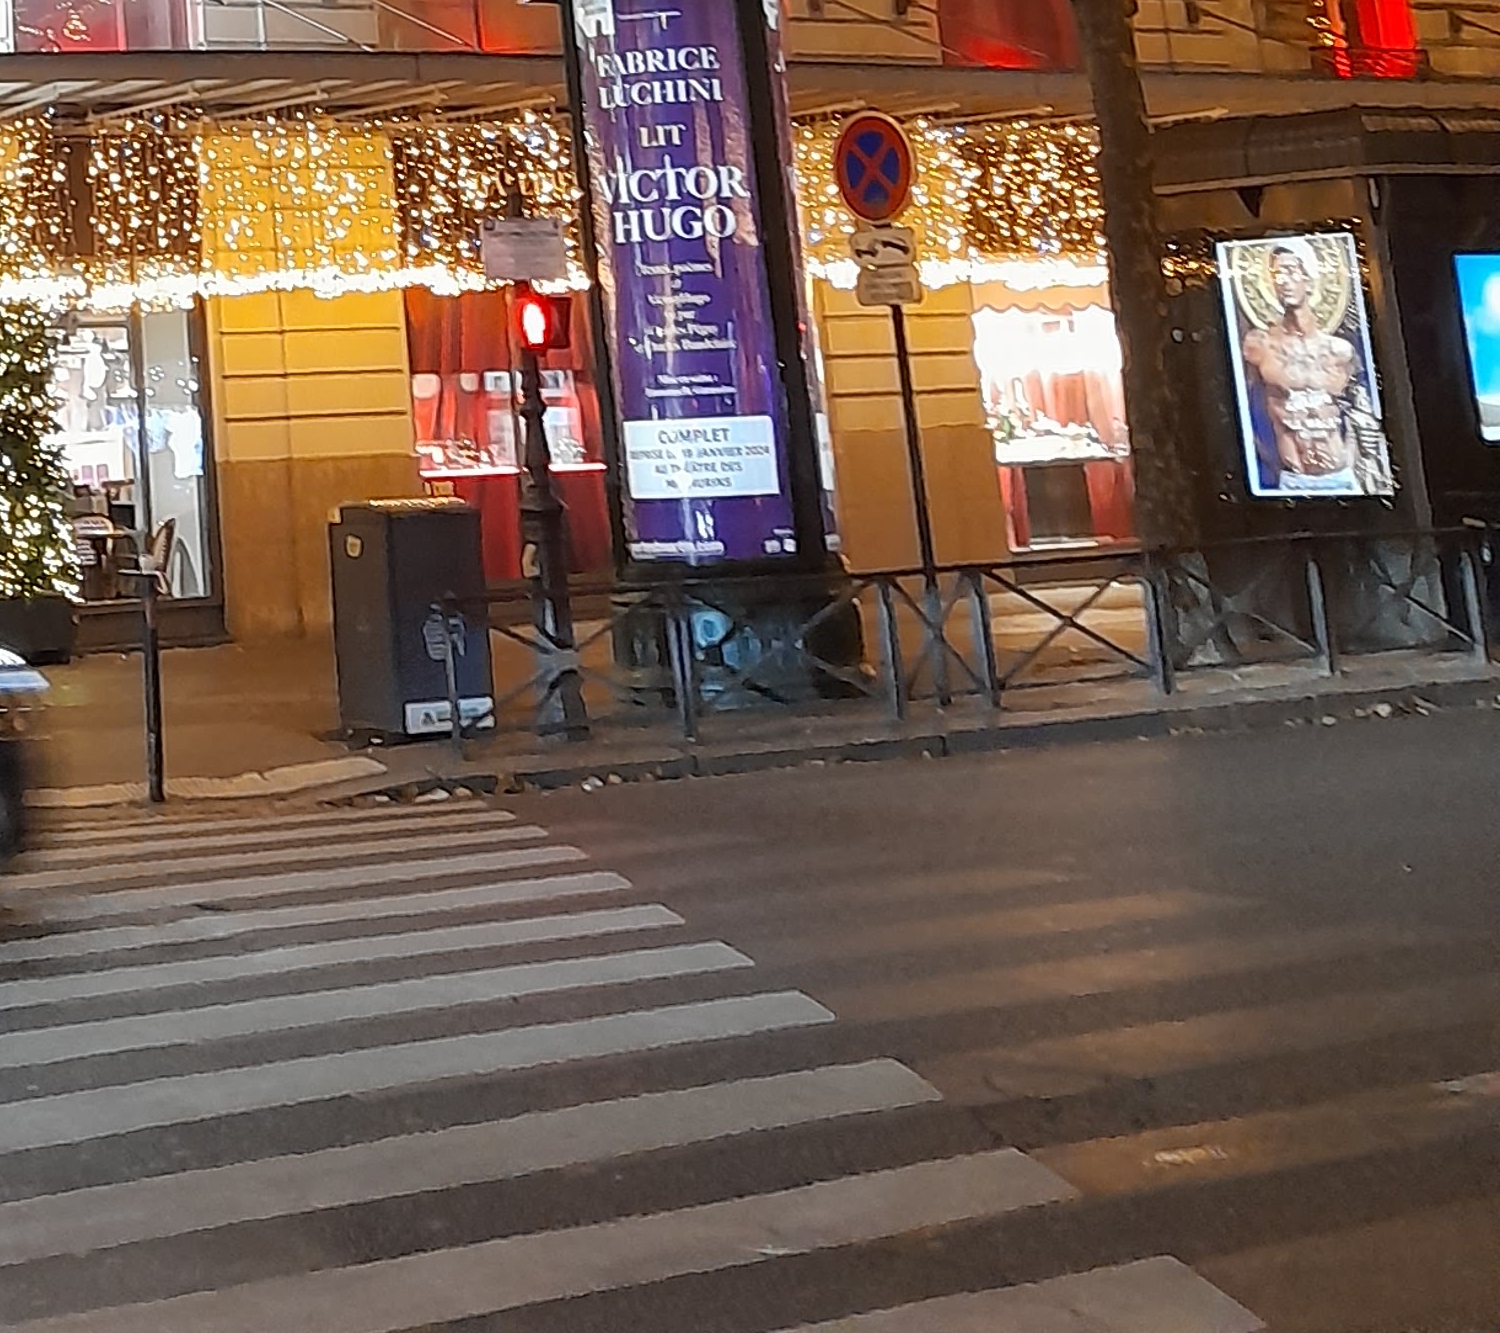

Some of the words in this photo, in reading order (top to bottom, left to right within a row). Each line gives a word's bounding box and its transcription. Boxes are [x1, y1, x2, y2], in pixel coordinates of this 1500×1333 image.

[597, 46, 720, 77] FABRICE
[598, 79, 723, 109] LUCHINI
[639, 124, 686, 147] LIT
[600, 166, 750, 205] VICTOR
[613, 205, 736, 244] HUGO
